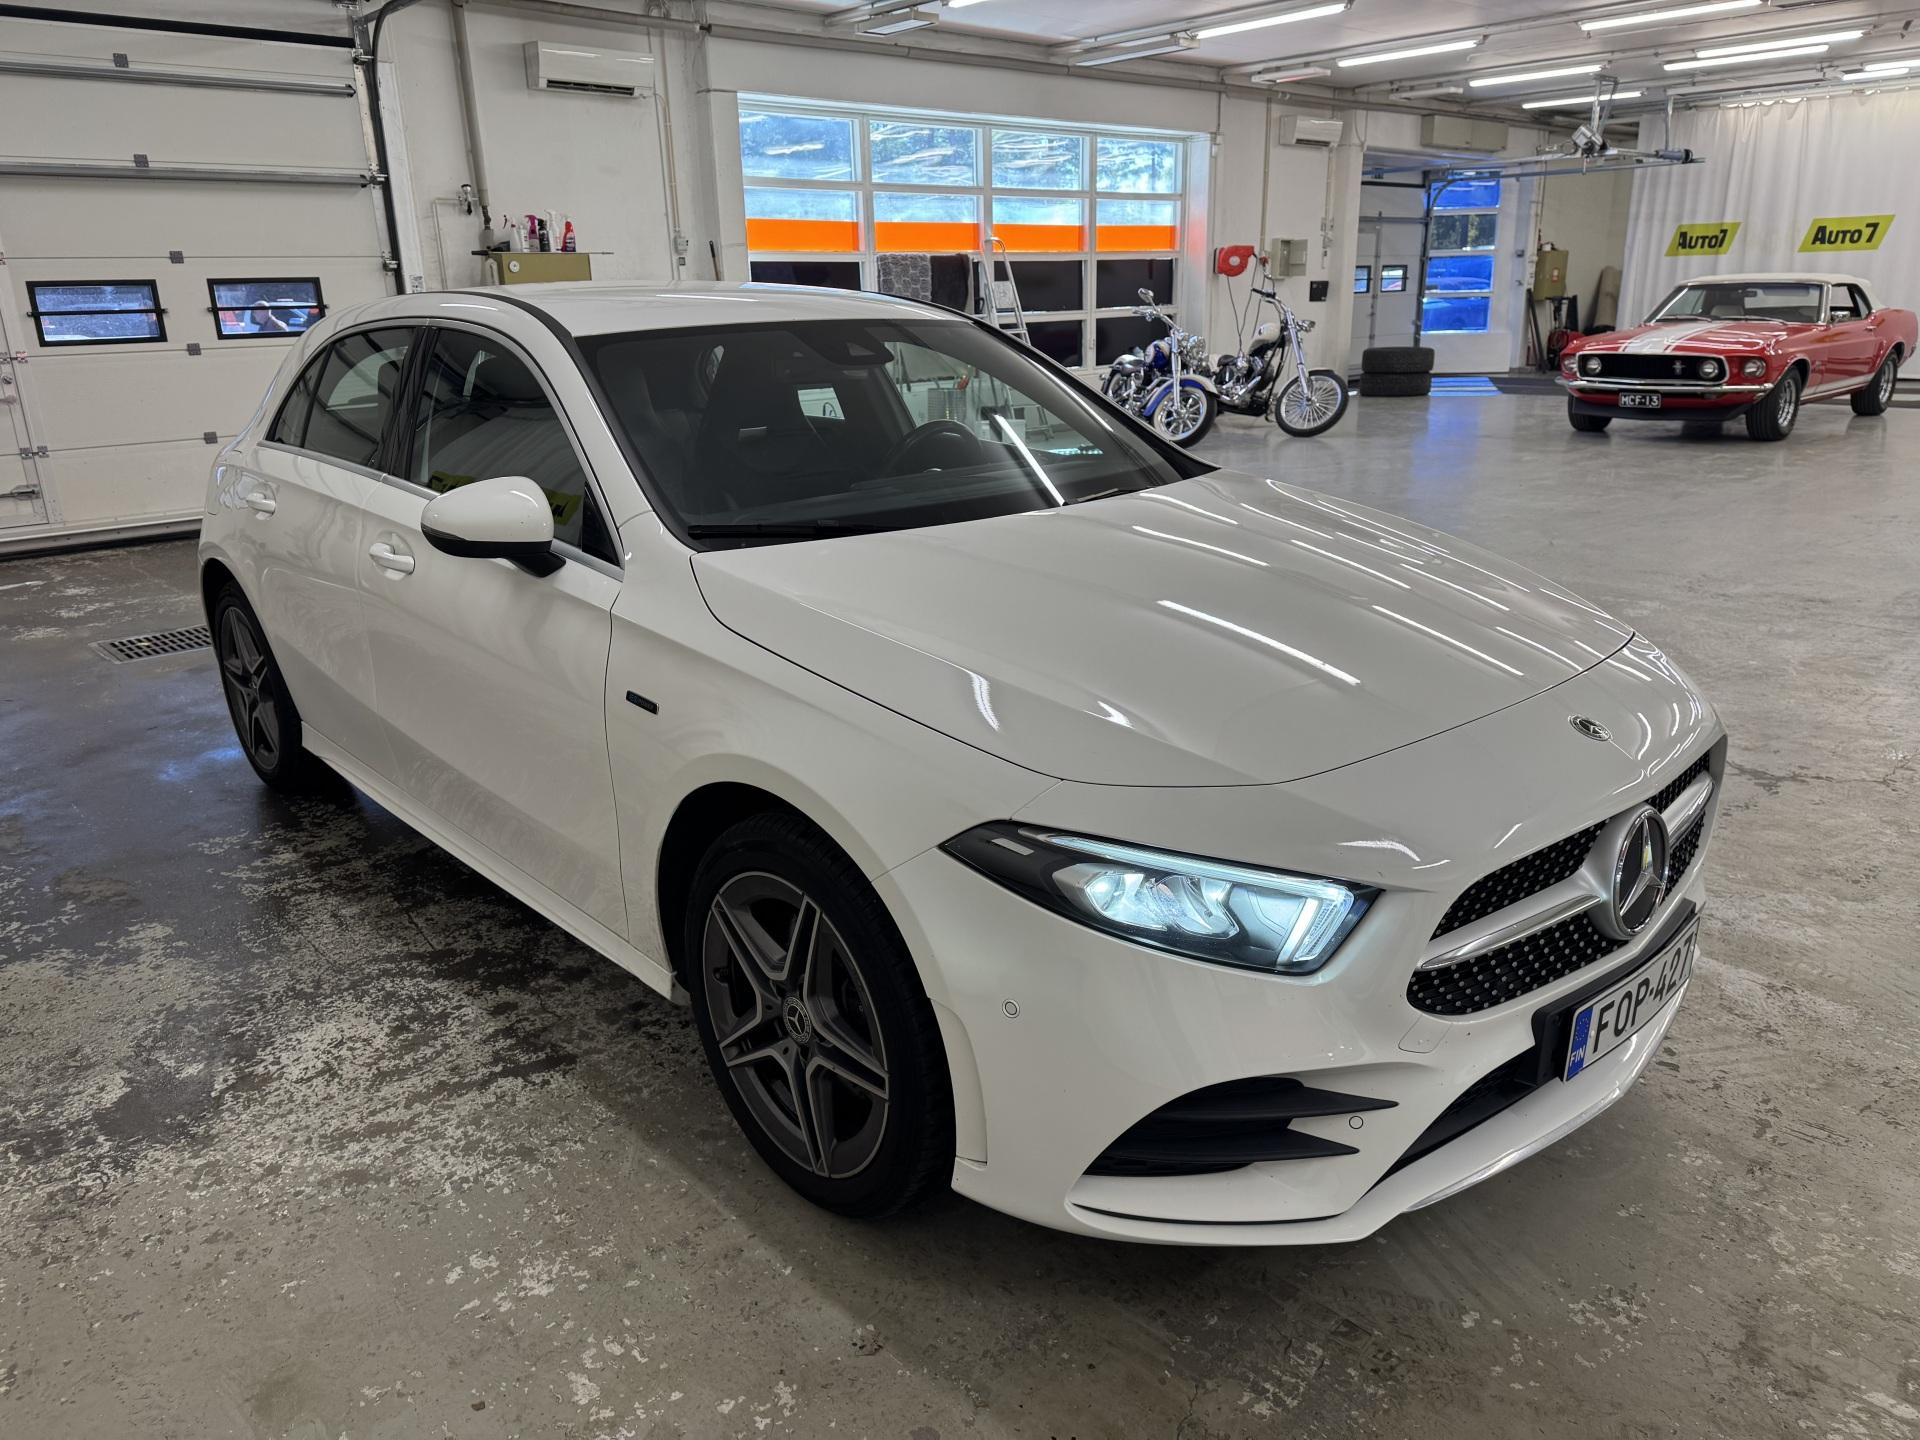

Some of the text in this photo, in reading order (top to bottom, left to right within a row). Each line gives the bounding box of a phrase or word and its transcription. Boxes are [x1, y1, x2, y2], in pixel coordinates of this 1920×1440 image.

[1865, 222, 1880, 243] 7
[1621, 395, 1659, 406] MCF-13
[1593, 930, 1696, 1053] FOP-427
[1569, 1045, 1585, 1067] FIN
